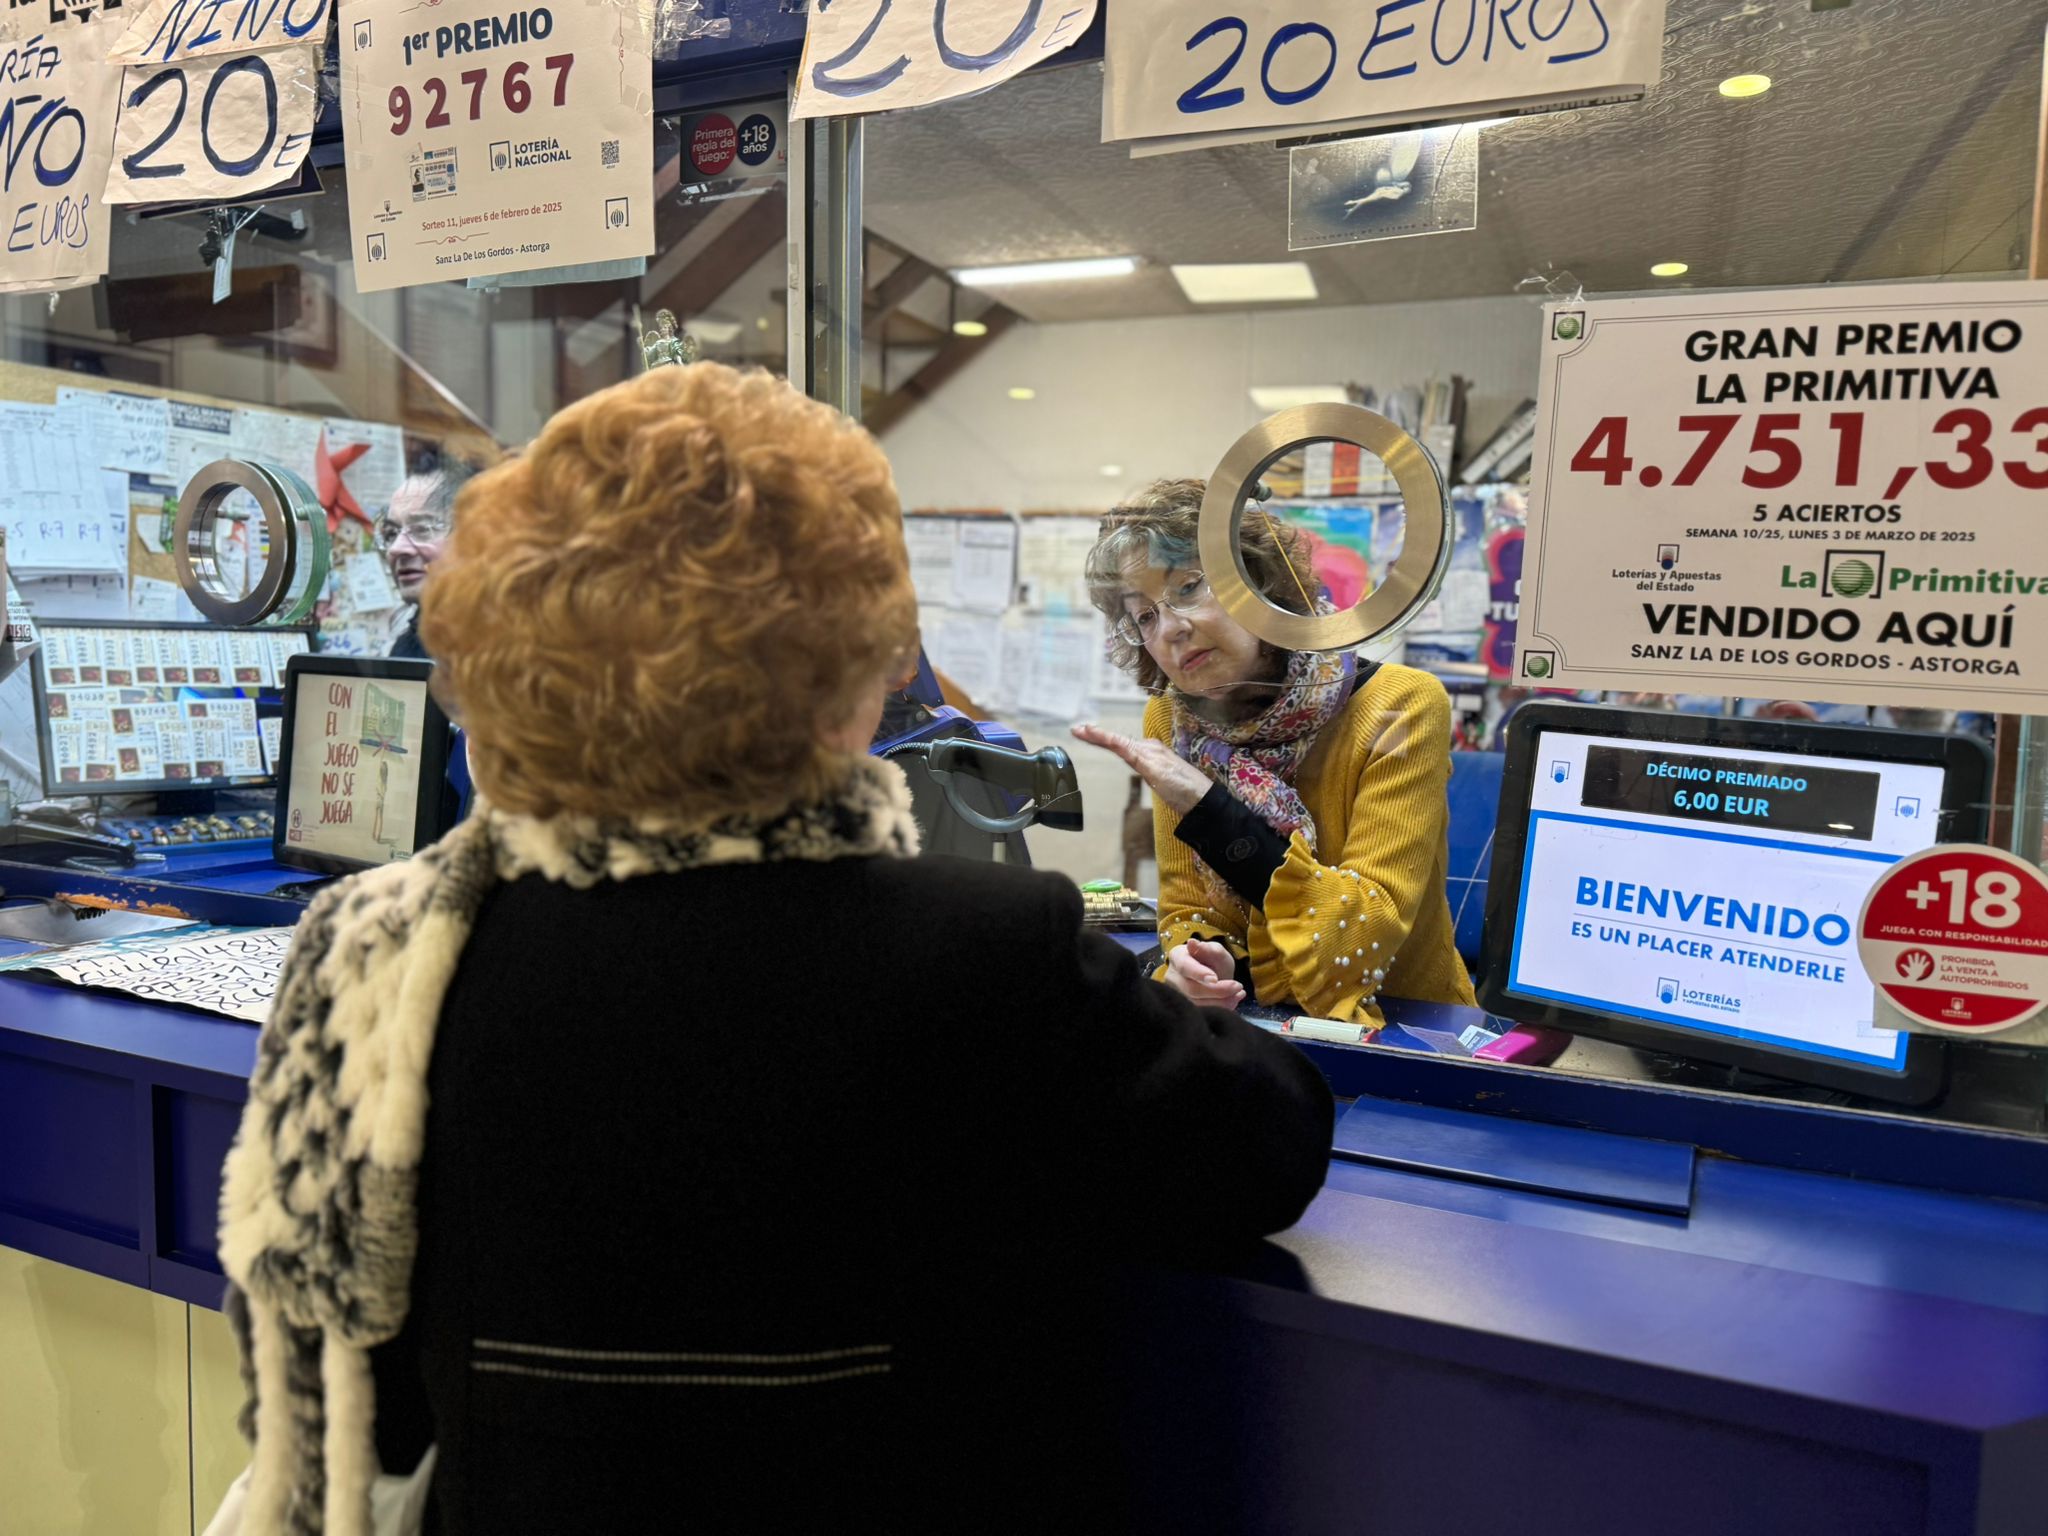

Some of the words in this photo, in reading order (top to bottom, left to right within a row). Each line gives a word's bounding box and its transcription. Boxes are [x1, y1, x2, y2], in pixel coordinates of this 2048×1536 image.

[402, 31, 430, 66] 1er
[436, 7, 553, 58] PREMIO
[812, 0, 1044, 97] 20
[1176, 16, 1337, 114] 20
[388, 53, 574, 136] 92767
[122, 54, 278, 180] 20
[514, 137, 559, 155] LOTERÍA
[692, 140, 717, 153] regla
[720, 137, 736, 147] del
[695, 127, 734, 140] Primera
[741, 124, 769, 143] +18
[515, 153, 572, 168] NACIONAL
[698, 151, 729, 165] juego:
[742, 142, 768, 154] años
[422, 217, 446, 231] Sorteo
[447, 216, 458, 227] 11,
[459, 214, 482, 228] jueves
[483, 212, 489, 222] 6
[489, 210, 500, 221] de
[501, 207, 530, 219] febrero
[530, 205, 541, 215] de
[543, 202, 562, 214] 2025
[435, 255, 452, 265] Sanz
[453, 252, 462, 263] La
[463, 251, 473, 261] De
[474, 249, 486, 259] Los
[487, 246, 514, 258] Gordos
[520, 241, 550, 254] Astorga
[1685, 325, 1818, 362] GRAN
[1836, 319, 2022, 356] PREMIO
[1696, 373, 1747, 404] LA
[1763, 367, 2000, 403] PRIMITIVA
[1570, 407, 2048, 501] 4.751,33
[1752, 504, 1767, 522] 5
[1777, 504, 1902, 523] ACIERTOS
[1685, 528, 1738, 539] SEMANA
[1743, 529, 1785, 541] 10/25,
[1789, 529, 1829, 540] LUNES
[1832, 530, 1841, 540] 3
[1845, 530, 1862, 541] DE
[1865, 530, 1915, 541] MARZO
[1919, 531, 1937, 541] DE
[1940, 531, 1976, 542] 2025
[1612, 568, 1657, 581] Loterías
[1660, 571, 1667, 582] y
[1669, 570, 1722, 583] Apuestas
[1636, 580, 1653, 592] del
[1656, 581, 1695, 593] Estado
[1780, 565, 1817, 588] La
[1889, 567, 2048, 595] Primitiva
[1642, 603, 1860, 643] VENDIDO
[1876, 603, 2016, 649] AQUÍ
[1631, 643, 1683, 660] SANZ
[1690, 646, 1713, 662] LA
[1719, 648, 1745, 663] DE
[1751, 649, 1789, 666] LOS
[1796, 652, 1891, 670] GORDOS
[1909, 656, 2020, 676] ASTORGA
[329, 682, 352, 709] CON
[325, 711, 337, 736] EL
[324, 742, 359, 768] JUEGO
[321, 772, 339, 795] NO
[342, 772, 356, 796] SE
[1646, 761, 1712, 782] DÉCIMO
[1716, 771, 1808, 792] PREMIADO
[320, 800, 352, 824] JUEGA
[1673, 790, 1720, 811] 6,00
[1724, 796, 1769, 817] EUR
[1576, 876, 1851, 946] BIENVENIDO
[1906, 868, 2021, 929] +18
[1880, 925, 1916, 935] JUEGA
[1918, 928, 1942, 937] CON
[1945, 931, 2048, 948] RESPONSABILIDAD
[1571, 921, 1593, 938] ES
[1600, 926, 1631, 945] UN
[1637, 932, 1714, 960] PLACER
[1720, 948, 1846, 983] ATENDERLE
[1941, 955, 1996, 967] PROHIBIDA
[1940, 975, 2029, 990] AUTOPROHIBIDOS
[1941, 965, 1953, 973] LA
[1956, 967, 1988, 977] VENTA
[1683, 989, 1741, 1008] LOTERÍAS
